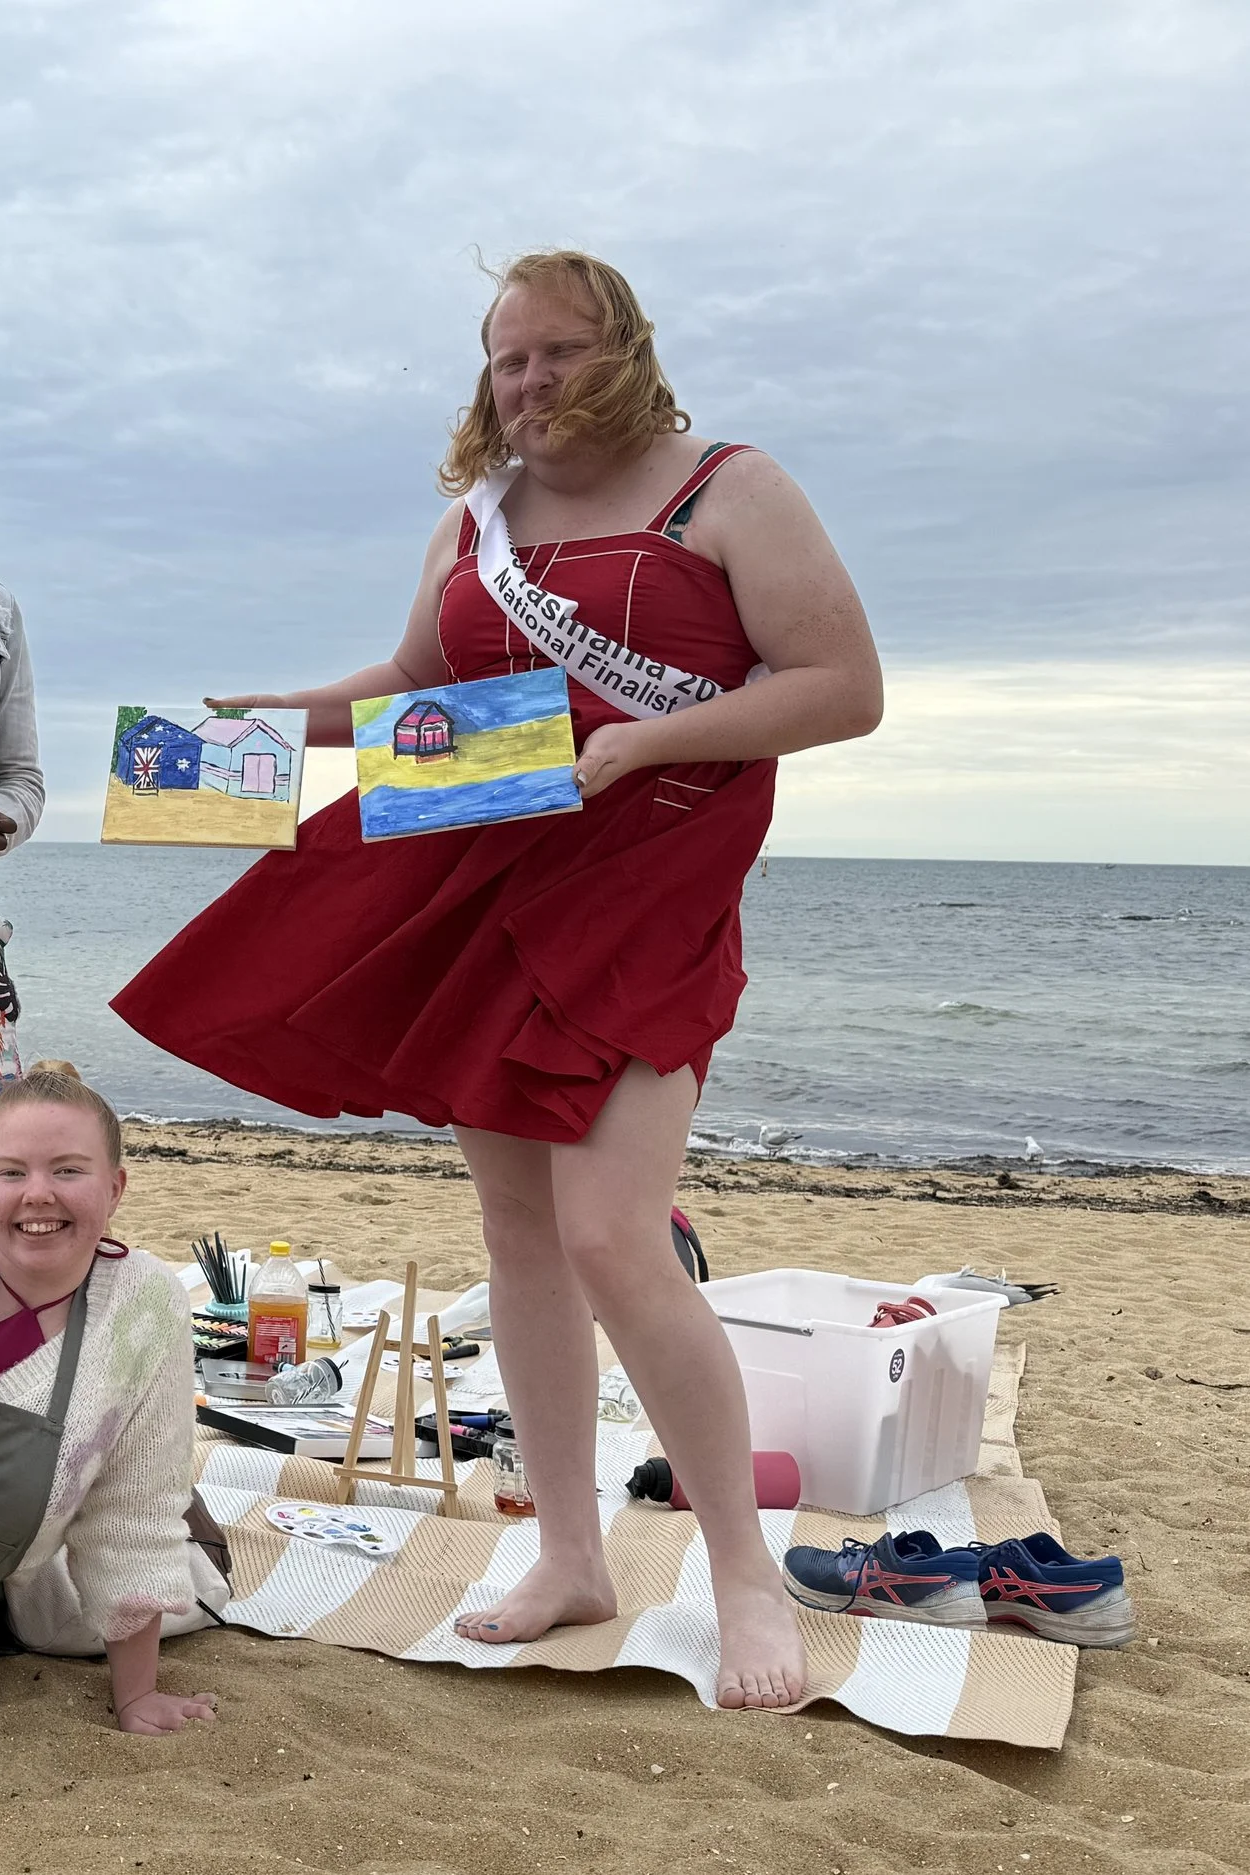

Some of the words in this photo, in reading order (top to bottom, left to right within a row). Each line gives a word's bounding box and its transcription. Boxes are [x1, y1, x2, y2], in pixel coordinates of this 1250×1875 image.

[493, 566, 575, 660] National
[576, 651, 679, 714] Finalist
[517, 579, 667, 681] asmania
[673, 672, 726, 702] 20
[891, 1358, 903, 1375] 52
